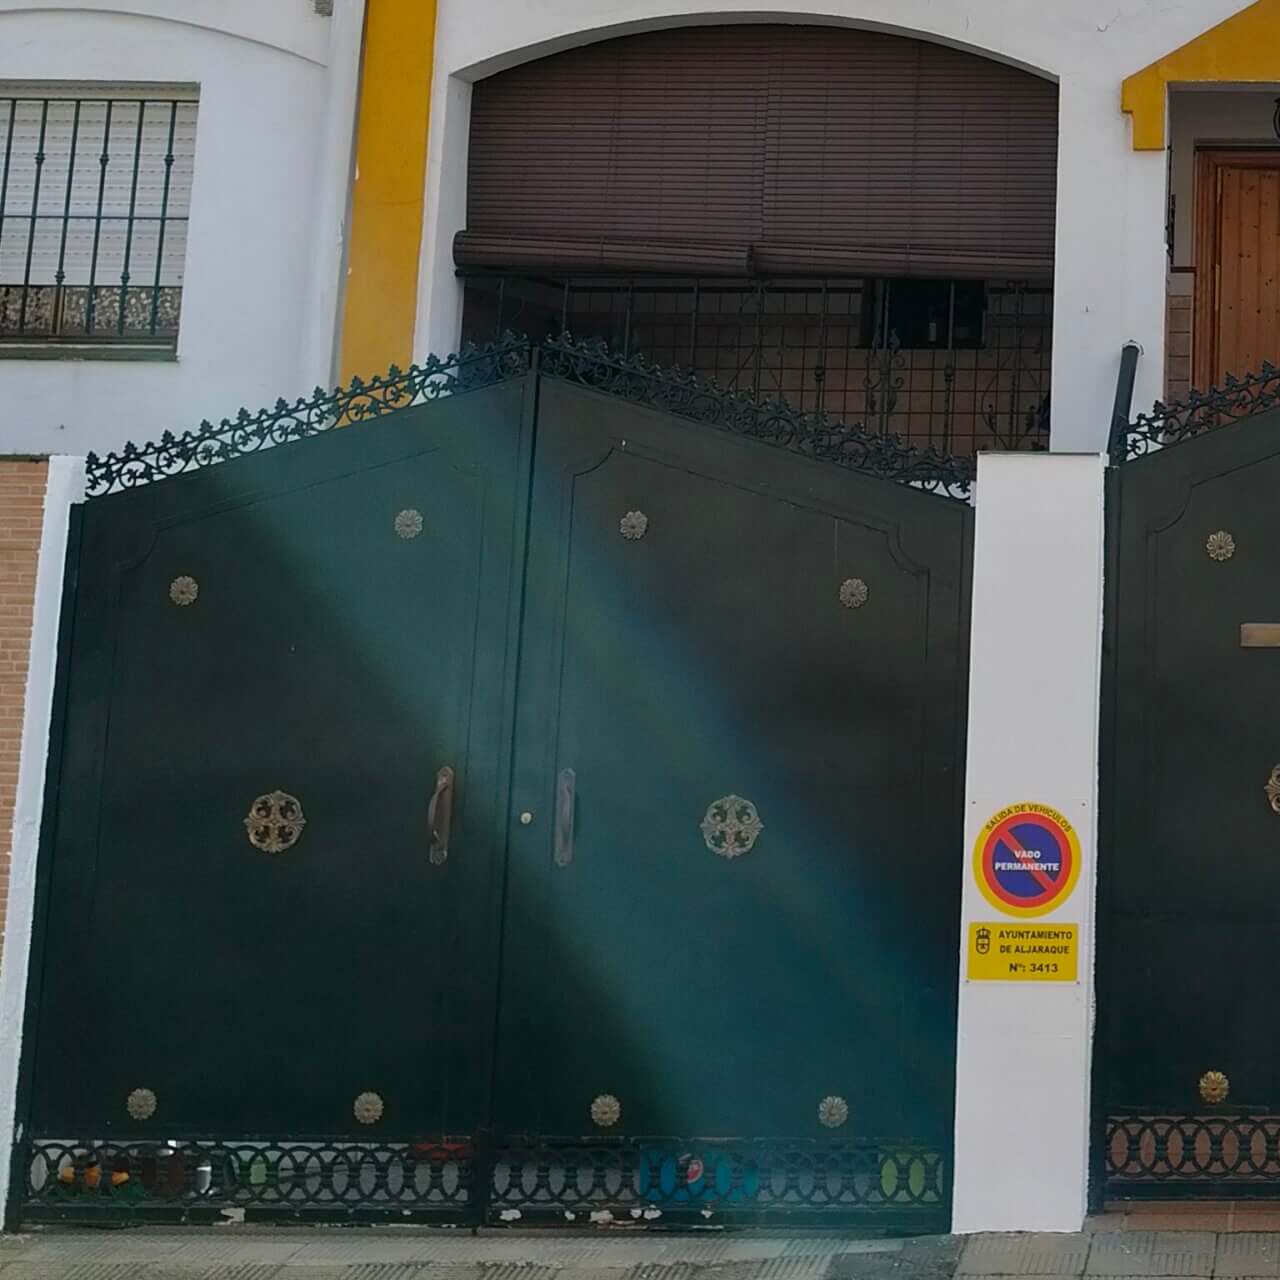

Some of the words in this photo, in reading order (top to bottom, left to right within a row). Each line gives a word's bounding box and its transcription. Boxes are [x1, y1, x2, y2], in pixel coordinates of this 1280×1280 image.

[985, 808, 1013, 831] SALIDA
[1014, 804, 1027, 813] DE
[1014, 850, 1041, 859] VADO
[995, 862, 1060, 871] PERMANENTE
[998, 930, 1073, 940] AYUNTAMIENTO
[1000, 945, 1012, 953] DE
[1014, 945, 1070, 954] ALJARAQUE
[1030, 963, 1058, 973] 3413
